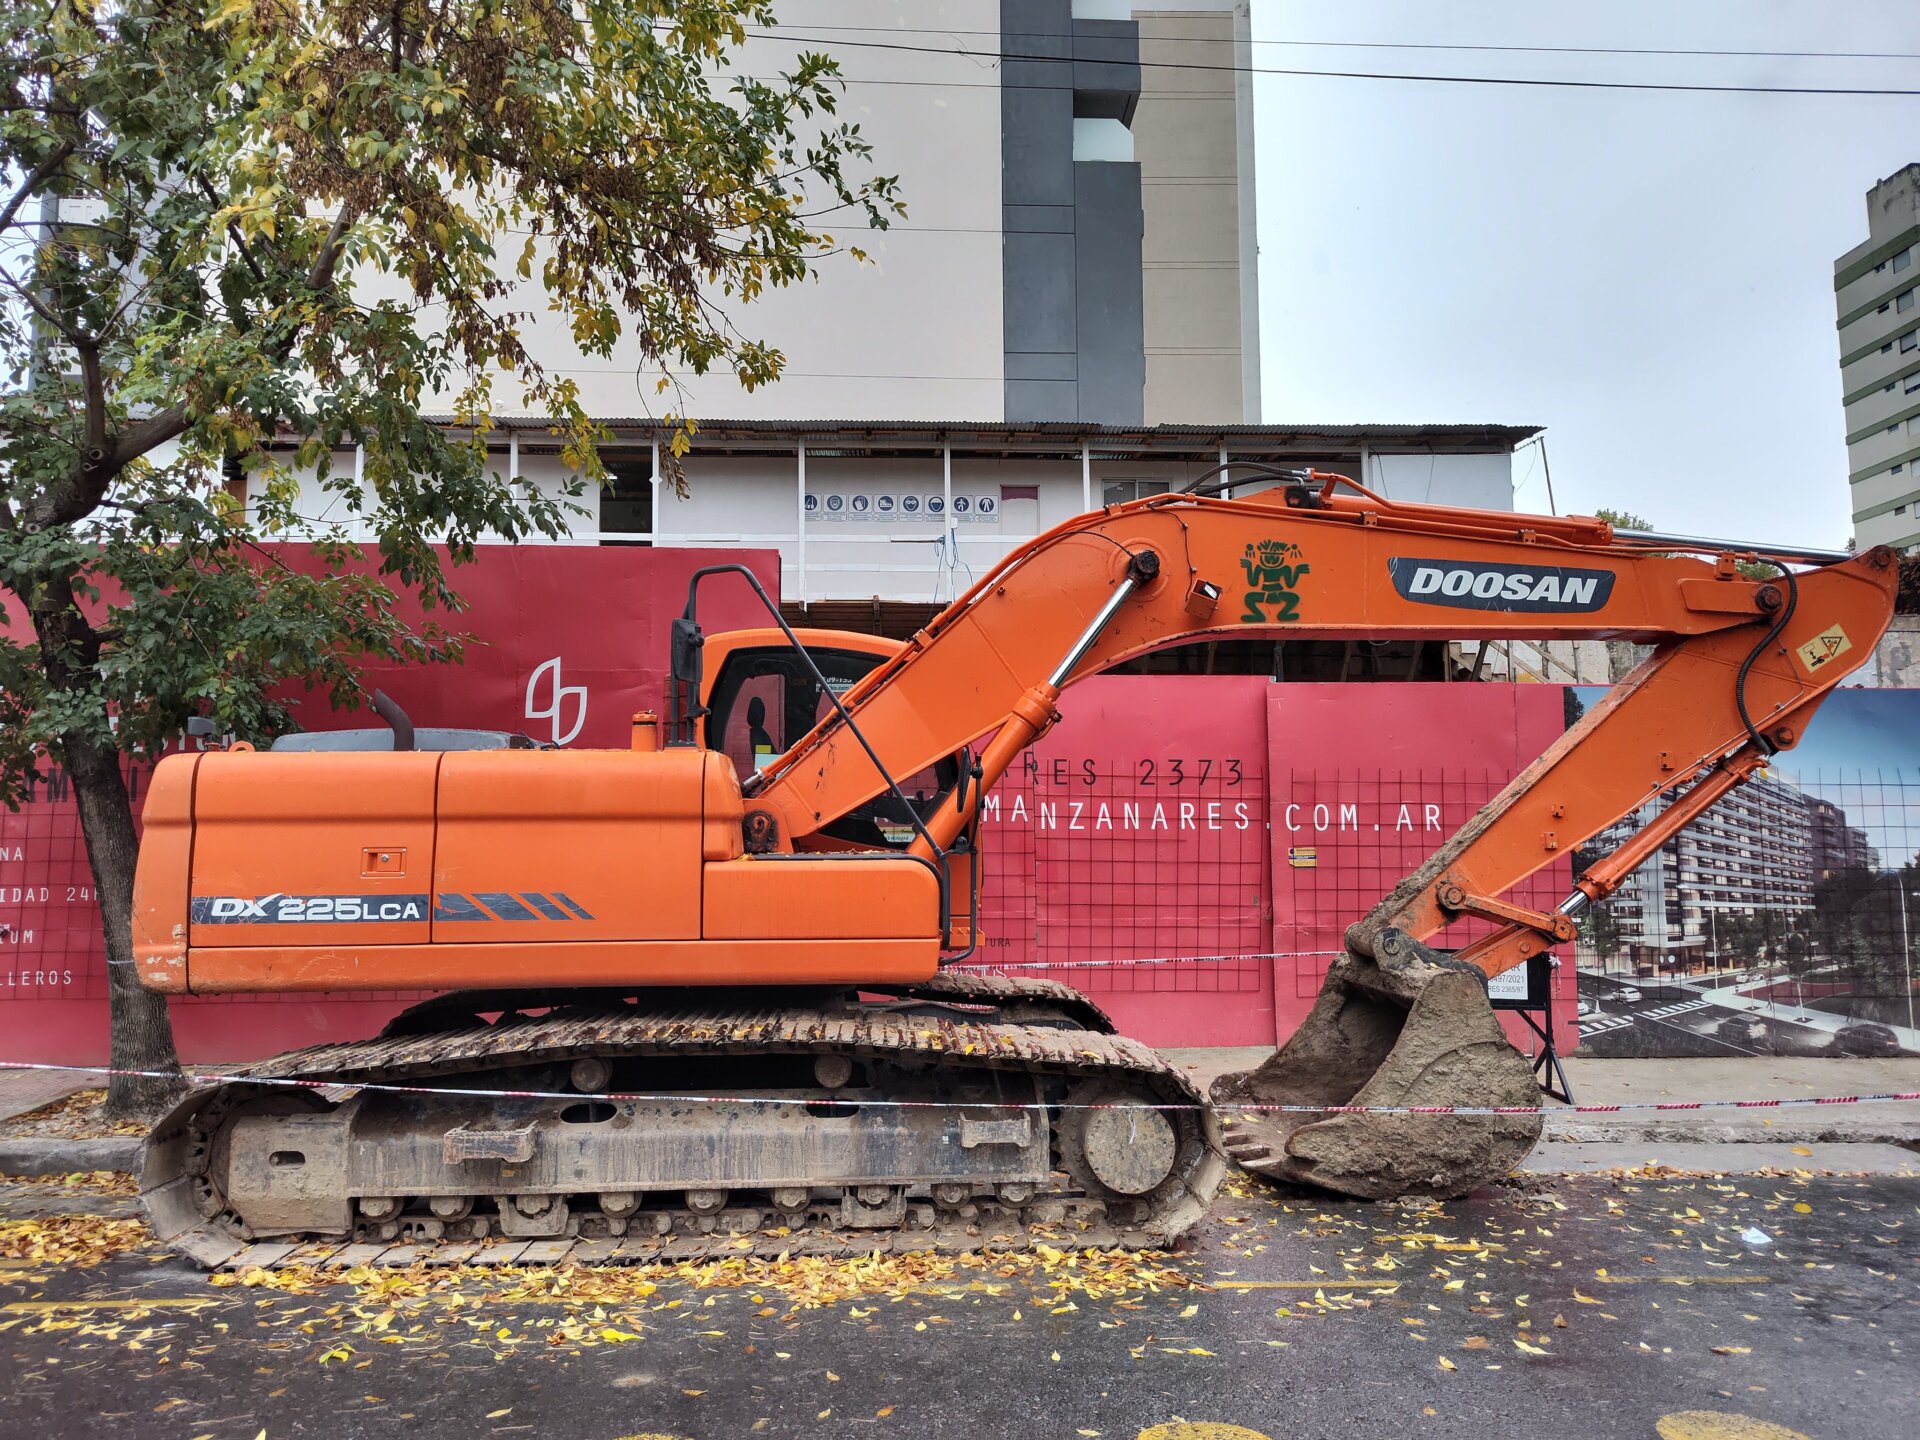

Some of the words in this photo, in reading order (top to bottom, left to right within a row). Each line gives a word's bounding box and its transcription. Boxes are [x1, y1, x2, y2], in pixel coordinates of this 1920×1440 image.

[1409, 567, 1598, 604] DOOSAN
[1003, 751, 1097, 786] RES
[1139, 758, 1243, 786] 2373
[0, 930, 33, 945] UM
[0, 970, 72, 986] LEROS
